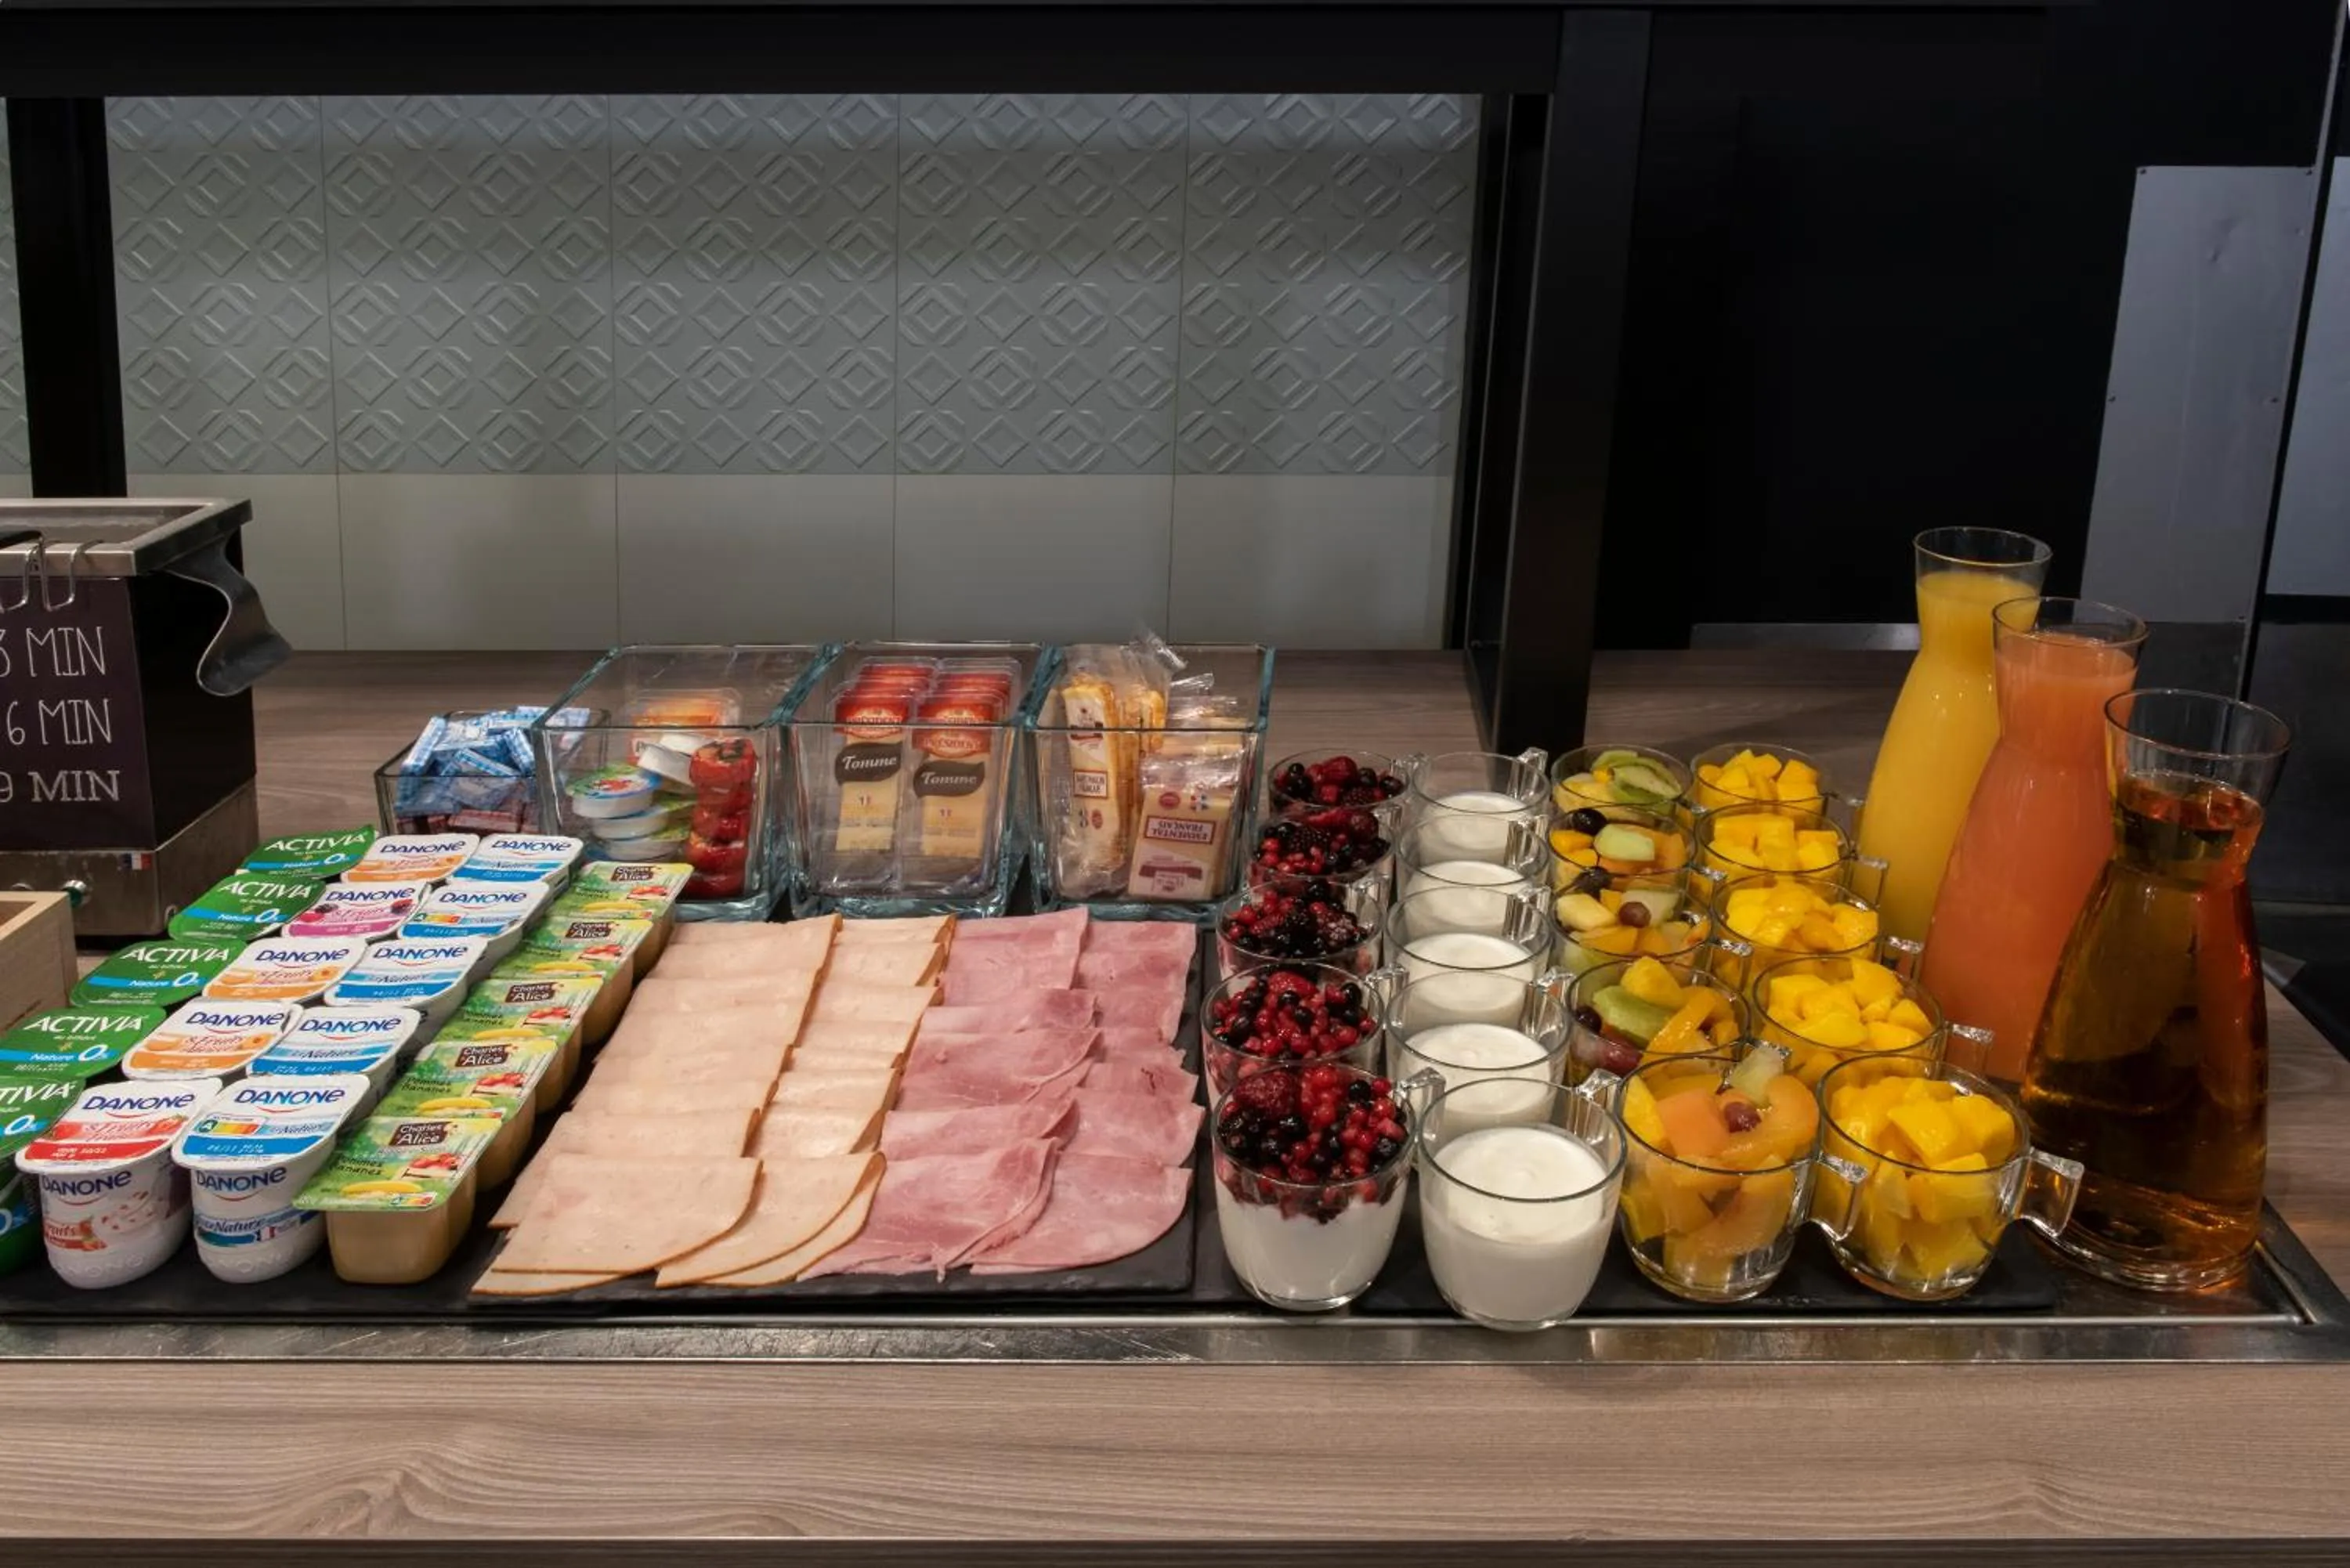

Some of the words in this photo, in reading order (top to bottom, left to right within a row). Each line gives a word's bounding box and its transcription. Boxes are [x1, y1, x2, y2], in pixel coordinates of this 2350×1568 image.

[25, 626, 107, 677] MIN
[6, 700, 26, 746] 6
[38, 698, 113, 746] MIN
[842, 755, 898, 771] Tomme
[27, 769, 121, 804] MIN
[920, 771, 978, 785] Tomme
[265, 833, 367, 851] ACTIVIA
[218, 881, 312, 899] ACTIVIA
[120, 947, 230, 963] ACTIVIA
[512, 992, 550, 1002] Alice
[24, 1016, 144, 1033] ACTIVIA
[462, 1054, 504, 1066] Alice
[81, 1093, 196, 1111] DANONE
[234, 1088, 346, 1106] DANONE
[399, 1123, 443, 1134] Charles
[396, 1133, 441, 1145] Alice
[196, 1166, 287, 1193] DANONE
